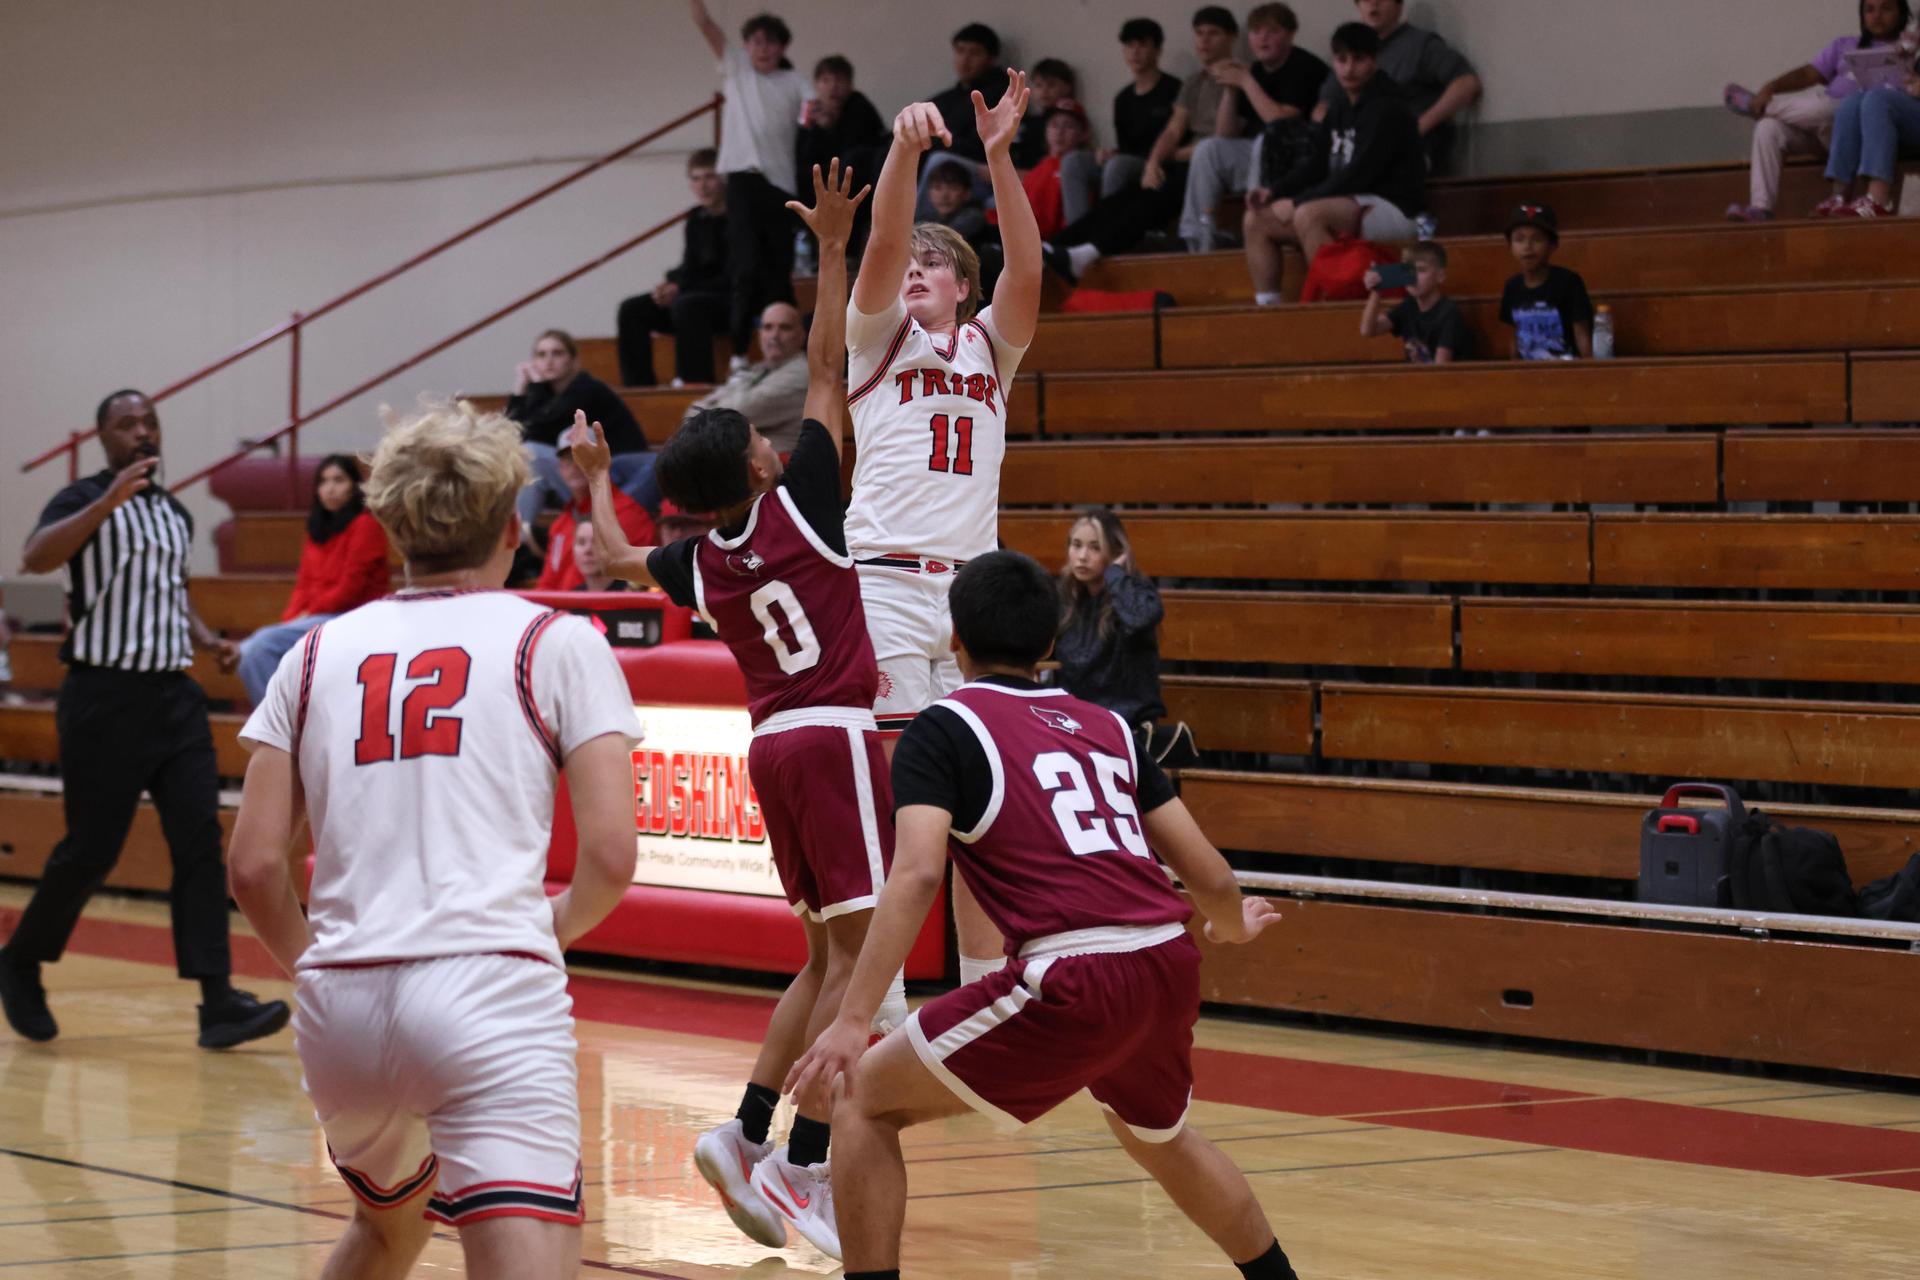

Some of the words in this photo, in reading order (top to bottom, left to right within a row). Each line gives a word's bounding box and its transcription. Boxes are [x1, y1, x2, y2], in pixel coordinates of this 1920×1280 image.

[896, 368, 998, 417] TRIBE
[929, 413, 974, 476] 11
[750, 579, 821, 675] 0
[355, 646, 472, 767] 12
[629, 748, 766, 845] EDSKINS
[1032, 751, 1150, 860] 25
[649, 850, 675, 866] Pride
[679, 852, 735, 874] Community
[739, 857, 765, 873] Wide
